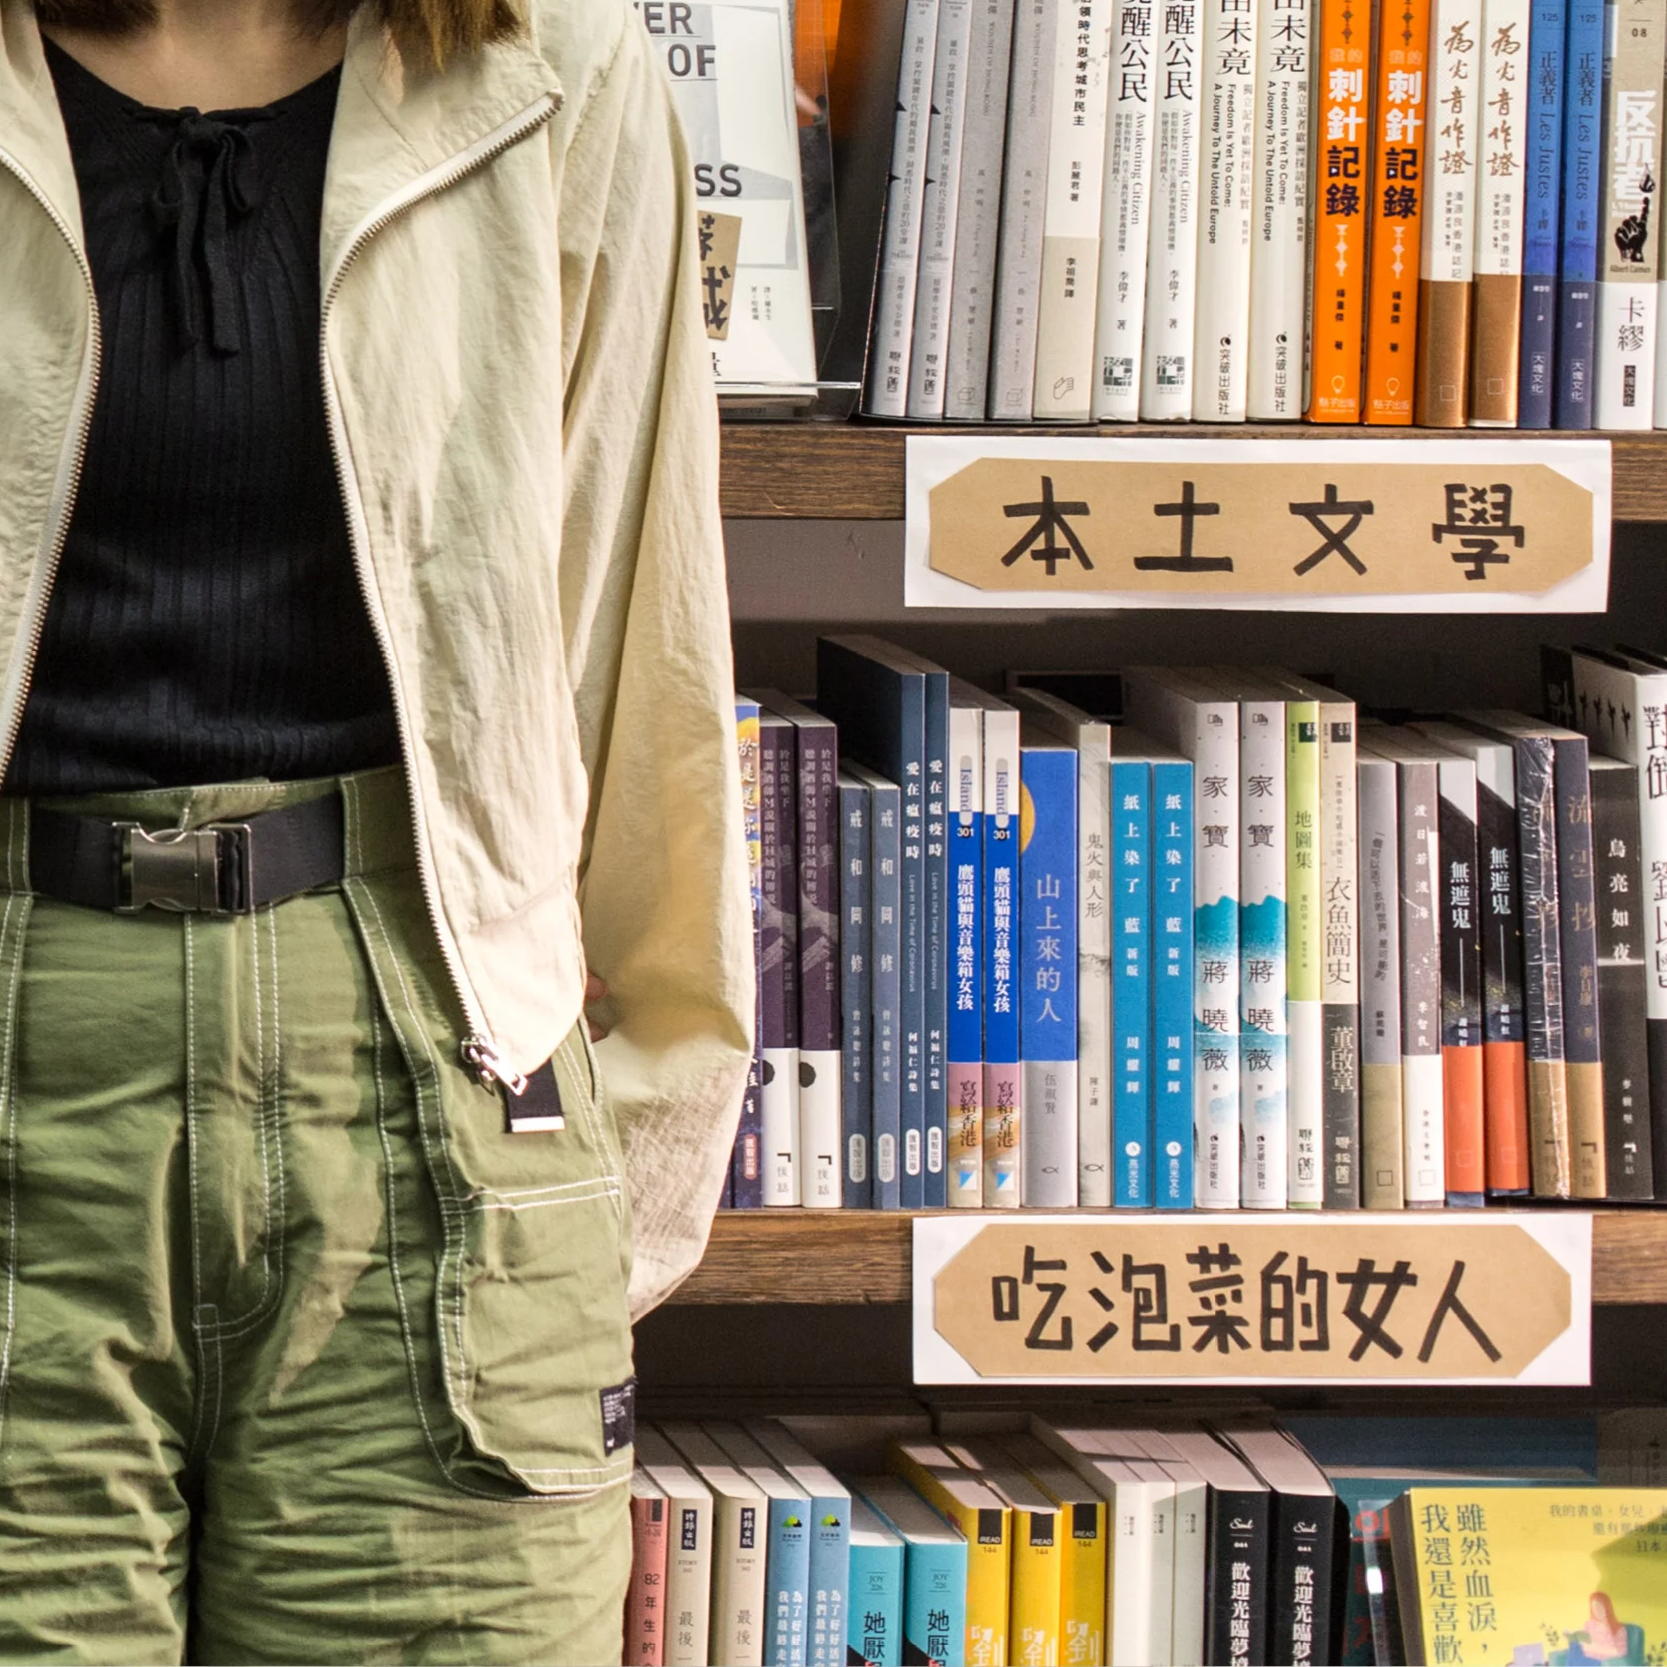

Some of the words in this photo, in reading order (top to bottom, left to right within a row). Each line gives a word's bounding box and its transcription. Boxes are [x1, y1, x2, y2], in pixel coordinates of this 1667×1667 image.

[1001, 475, 1525, 581] 本土文學
[957, 829, 974, 838] 301
[1036, 874, 1061, 1023] 山上來的人
[992, 1243, 1501, 1363] 吃泡菜的女人
[1421, 1503, 1455, 1666] 我還是喜歡
